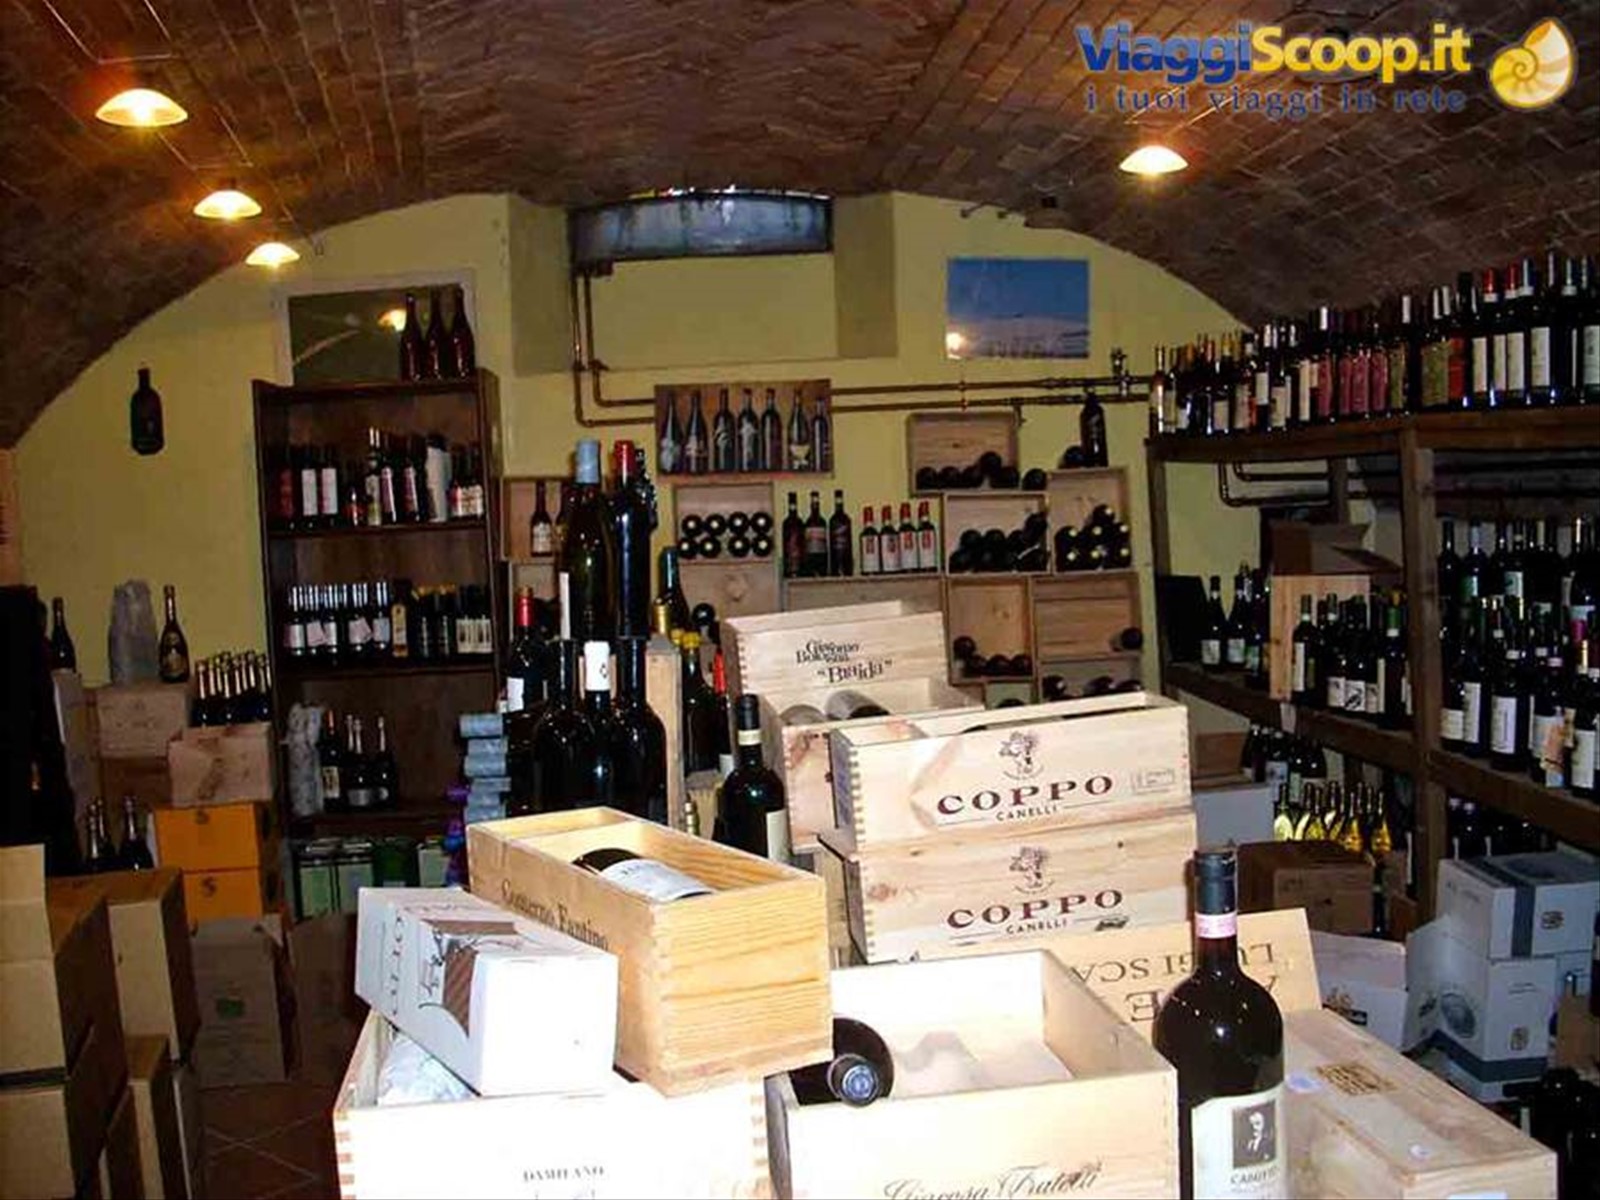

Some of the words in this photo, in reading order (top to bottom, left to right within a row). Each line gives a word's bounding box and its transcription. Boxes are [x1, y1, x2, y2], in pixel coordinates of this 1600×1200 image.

[937, 775, 1114, 816] COPPO
[996, 804, 1058, 822] CANELLI
[947, 889, 1123, 929] COPPO
[1006, 917, 1068, 935] CANELLI
